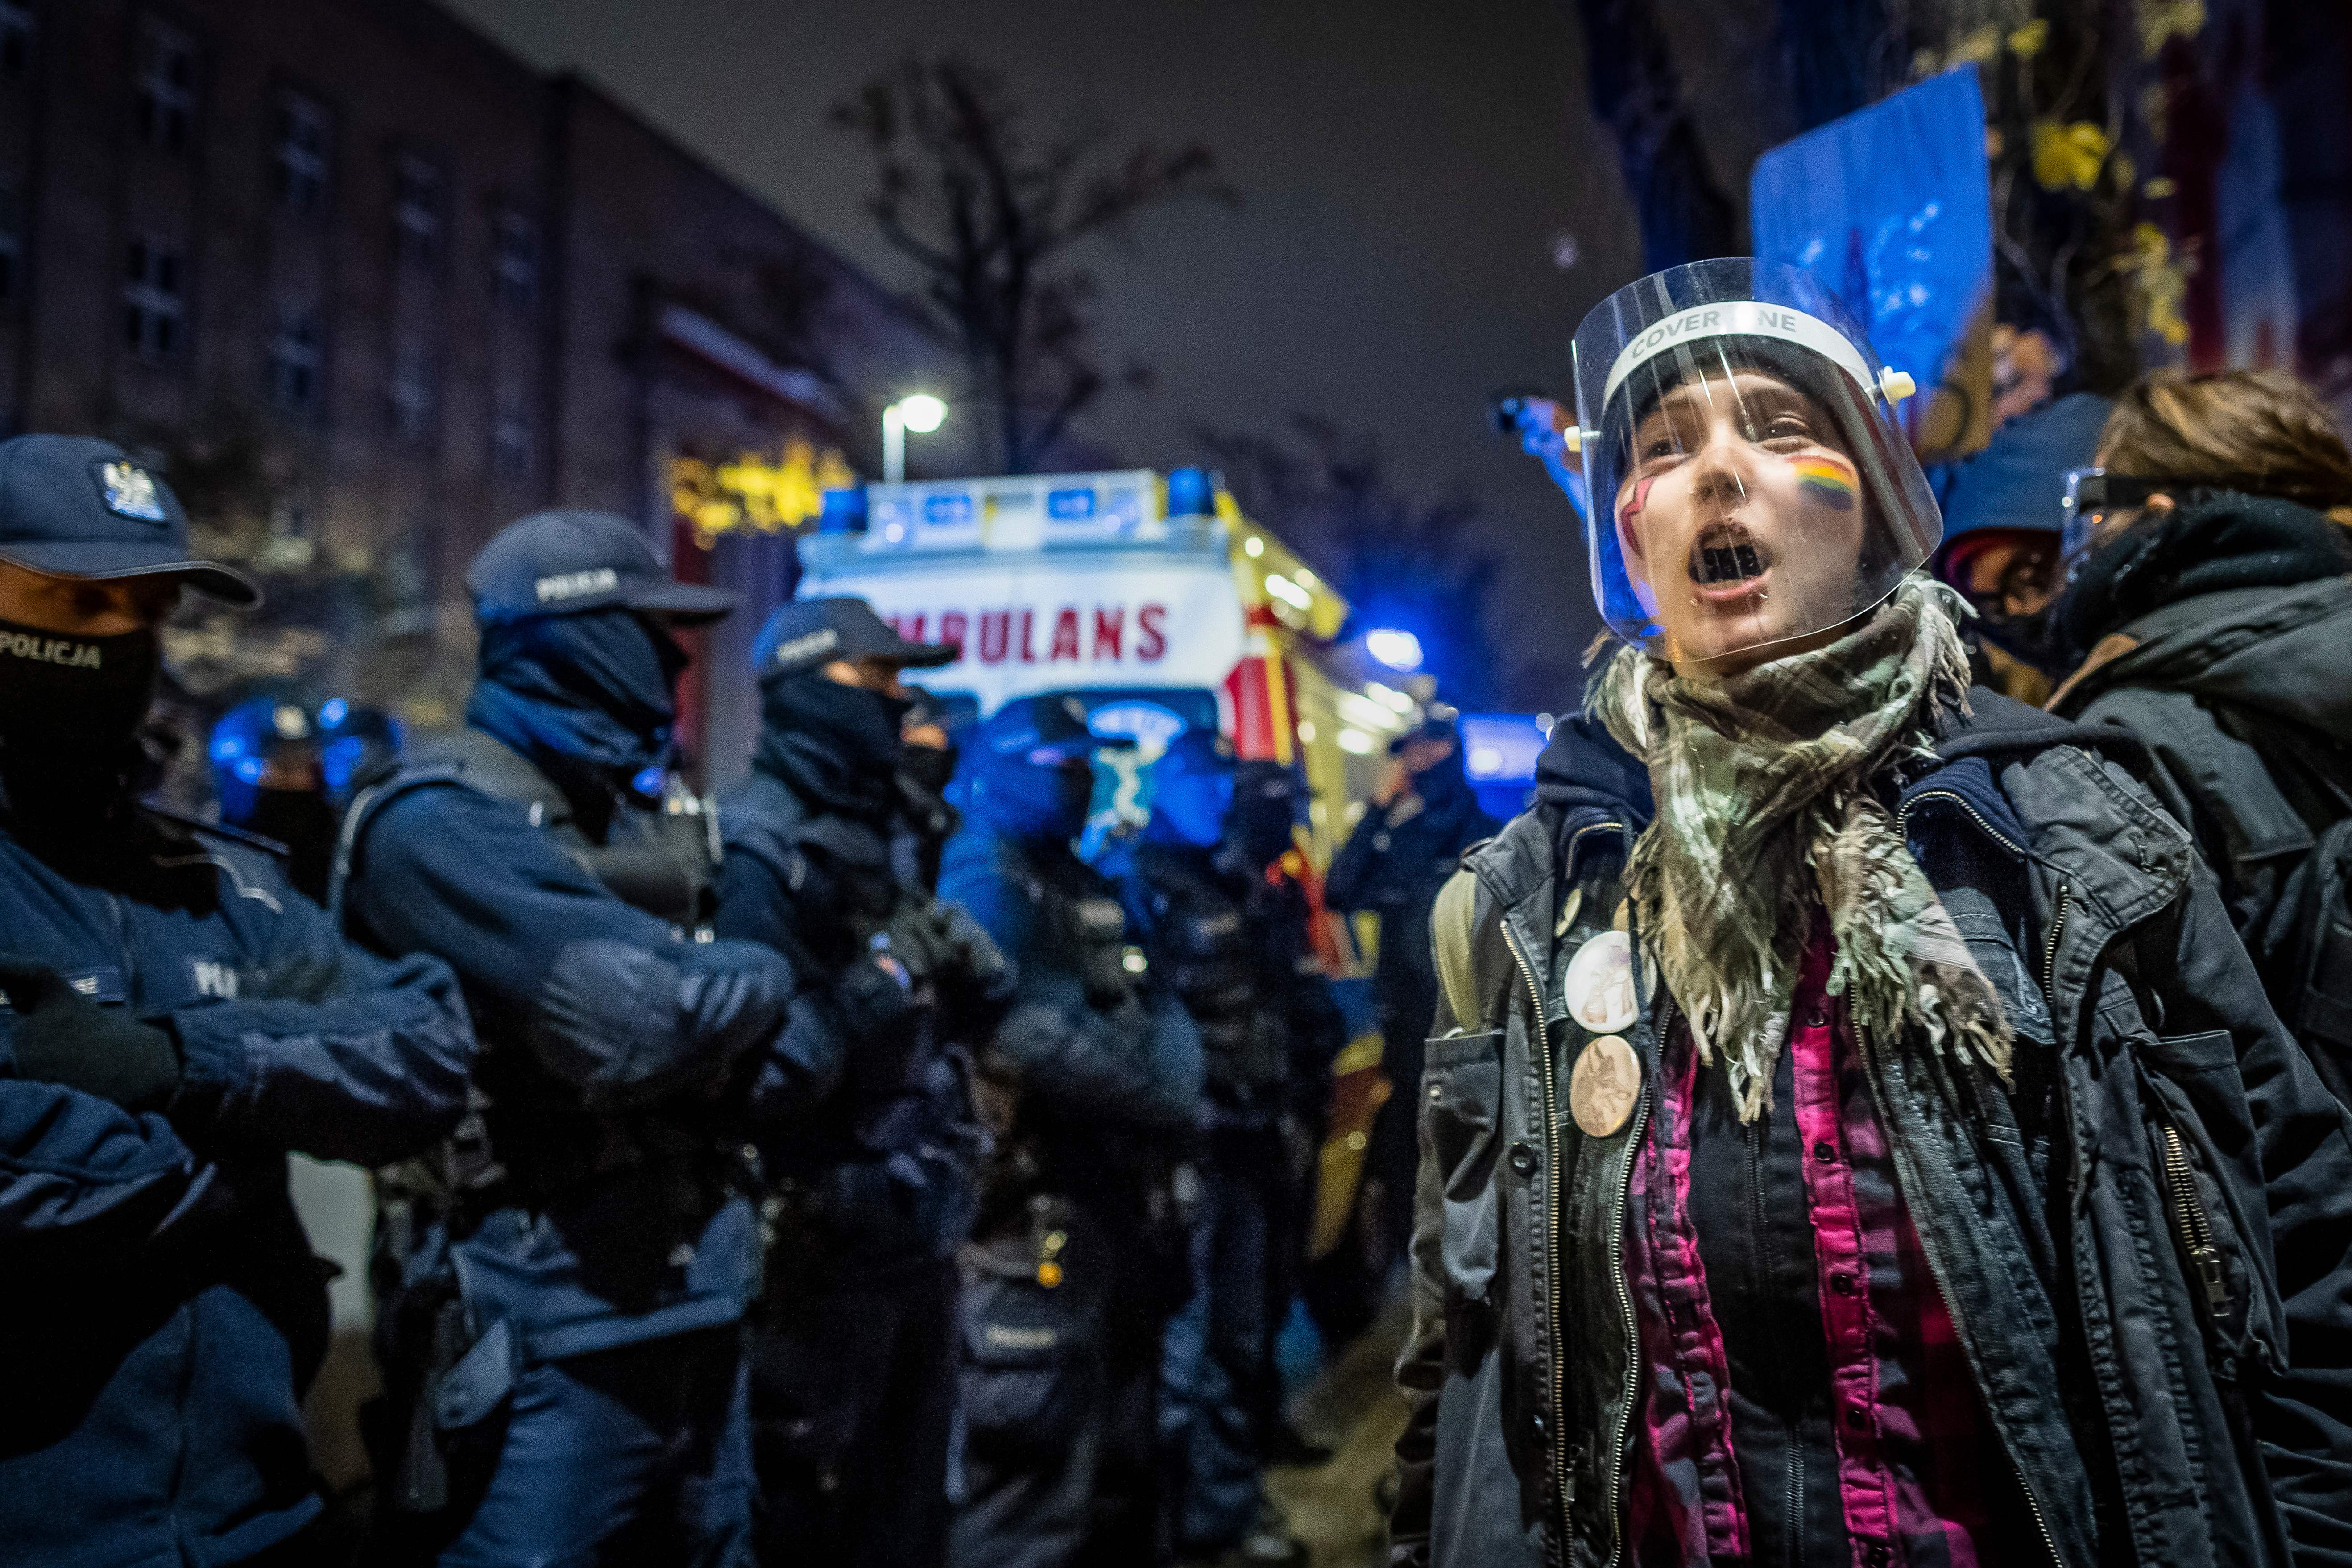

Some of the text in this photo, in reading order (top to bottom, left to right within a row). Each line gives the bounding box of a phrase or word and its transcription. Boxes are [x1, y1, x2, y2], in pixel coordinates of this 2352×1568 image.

[1632, 310, 1796, 359] COVER NE
[885, 604, 1167, 664] MBULANS
